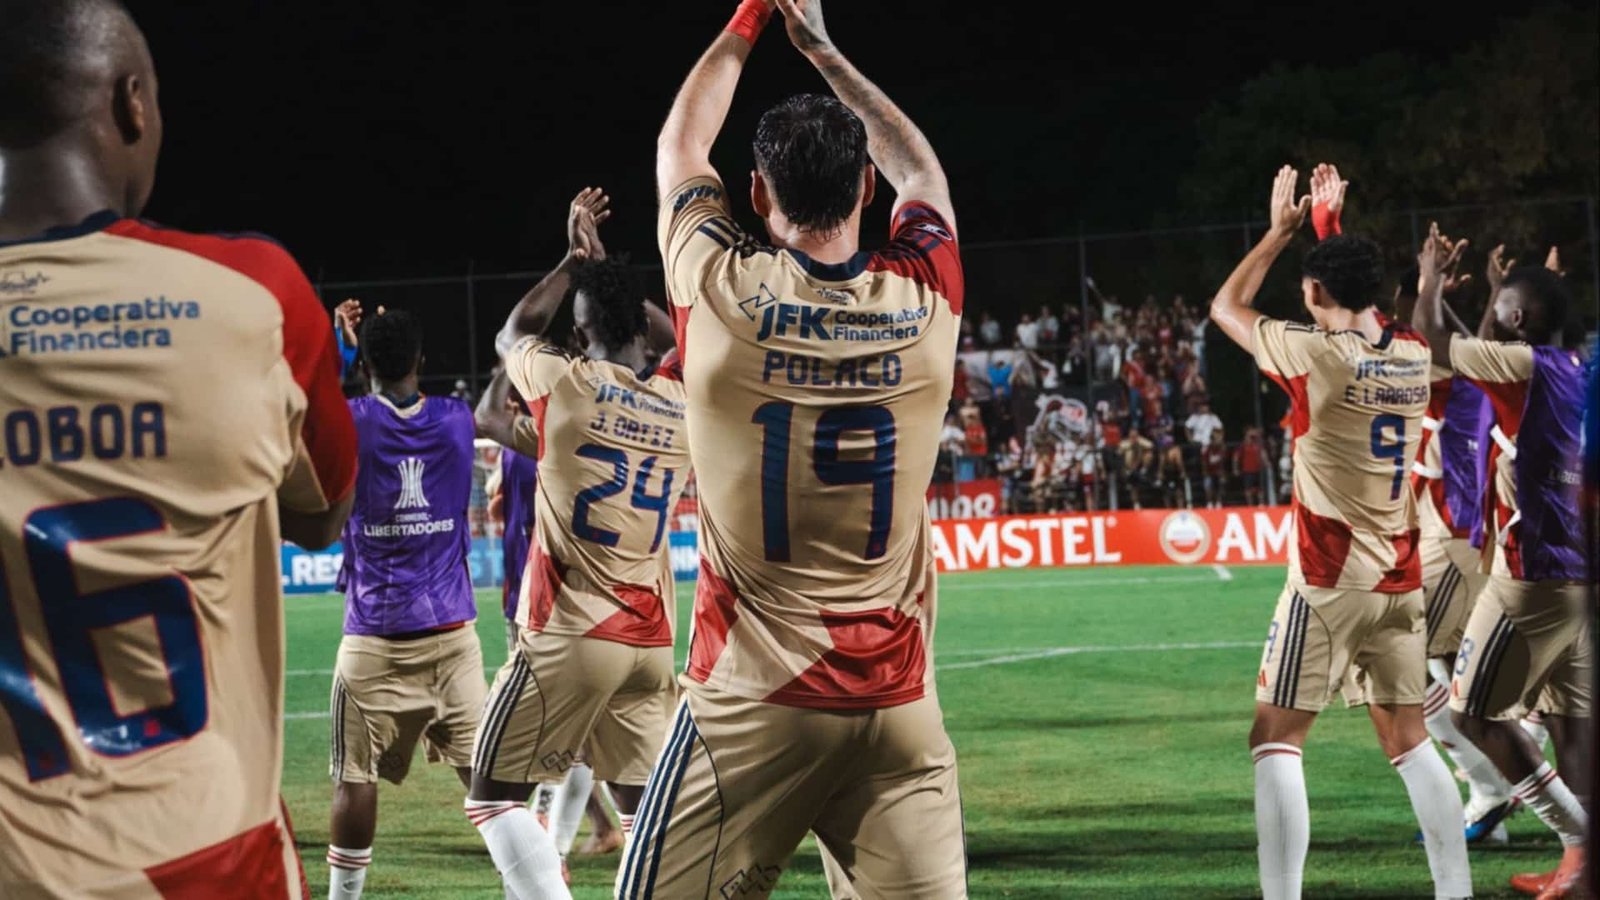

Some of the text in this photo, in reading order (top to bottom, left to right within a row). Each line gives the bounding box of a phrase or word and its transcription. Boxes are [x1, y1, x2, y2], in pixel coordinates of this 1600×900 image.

[10, 296, 200, 329] Cooperativa
[757, 303, 833, 342] JFK
[834, 305, 929, 328] Cooperativa
[10, 324, 172, 355] Financiera
[834, 323, 919, 342] Financiera
[762, 352, 903, 387] POLACO
[1356, 359, 1389, 381] JFK
[595, 383, 639, 410] JFK
[0, 401, 167, 469] OBOA
[1370, 413, 1406, 501] 9
[752, 401, 896, 562] 19
[571, 443, 674, 555] 24
[364, 519, 454, 537] LIBERTADORES
[932, 516, 1122, 571] AMSTEL
